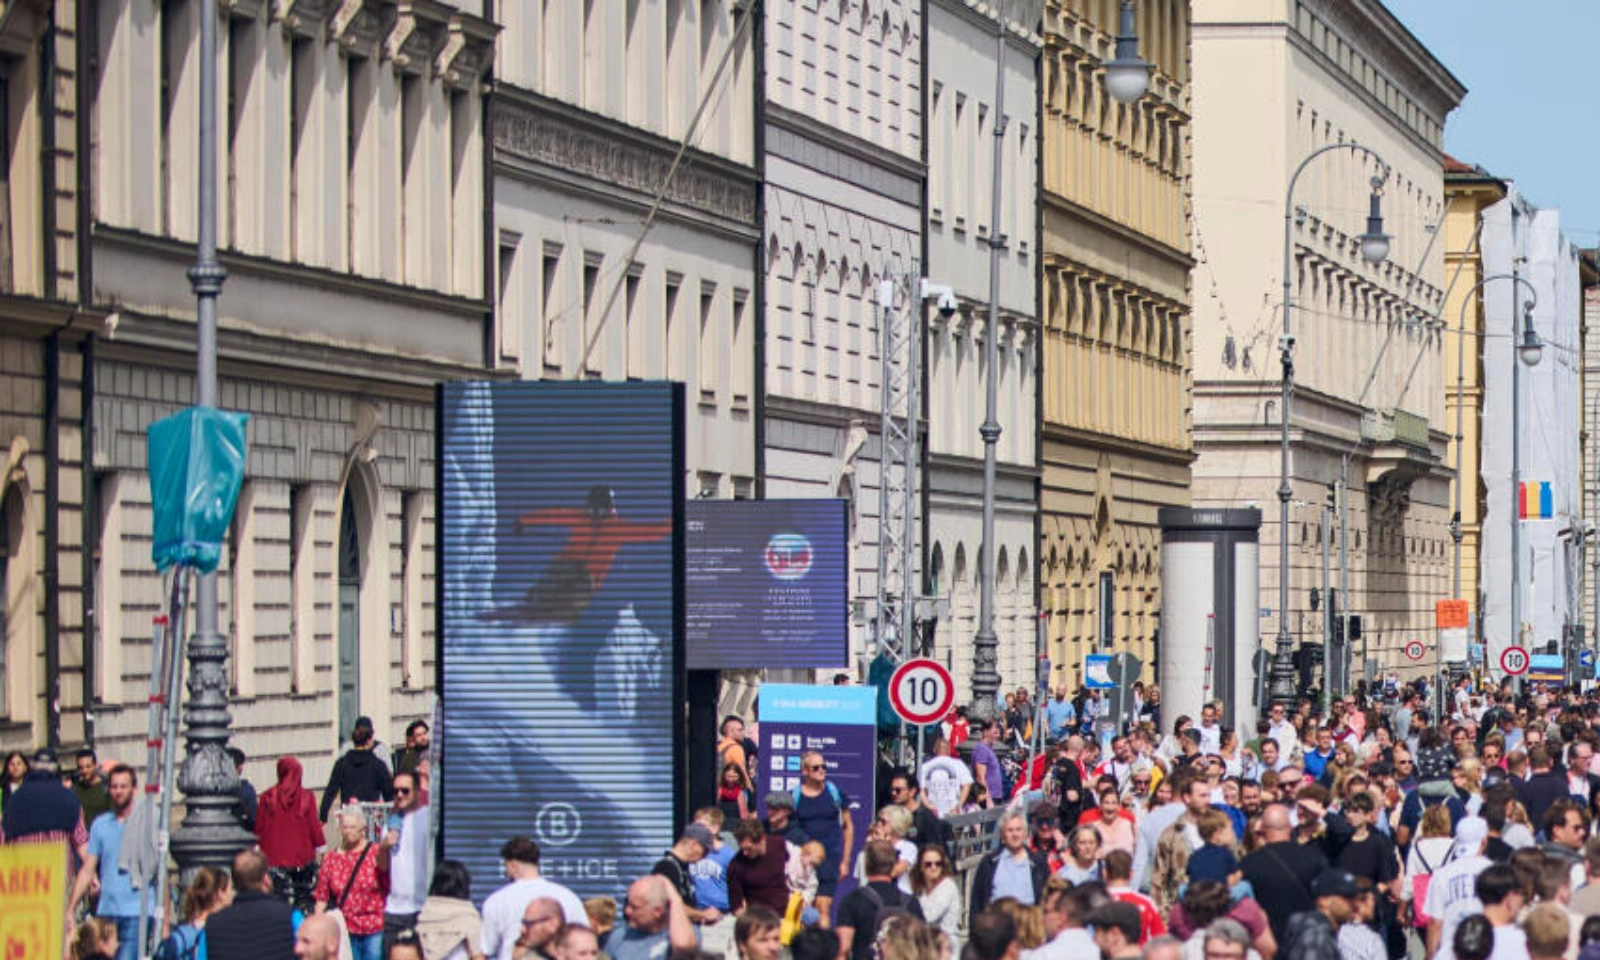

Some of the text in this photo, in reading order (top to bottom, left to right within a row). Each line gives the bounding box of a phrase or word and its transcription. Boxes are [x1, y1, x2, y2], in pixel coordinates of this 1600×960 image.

[1411, 647, 1420, 655] 10
[1508, 655, 1523, 667] 10
[907, 677, 938, 706] 10
[550, 811, 568, 836] B
[499, 859, 618, 879] E+ICE
